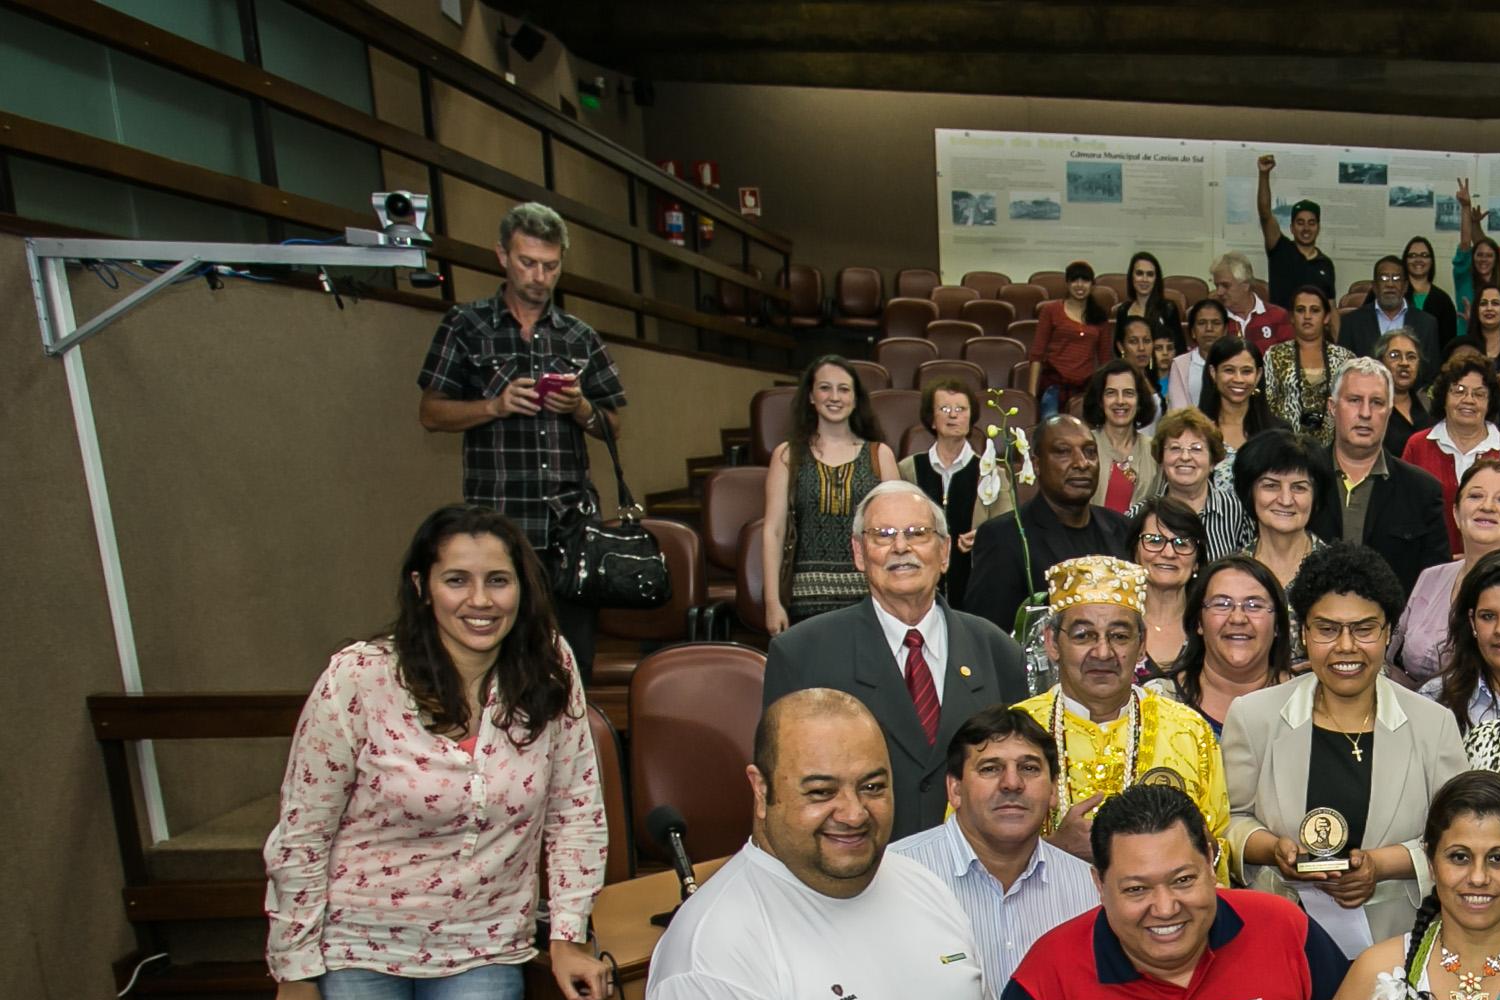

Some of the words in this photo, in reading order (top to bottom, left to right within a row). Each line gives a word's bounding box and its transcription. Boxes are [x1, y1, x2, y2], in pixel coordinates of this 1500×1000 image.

[1103, 151, 1140, 161] Municipal
[1143, 153, 1152, 161] de
[1180, 154, 1191, 162] do
[1192, 155, 1205, 163] Sul
